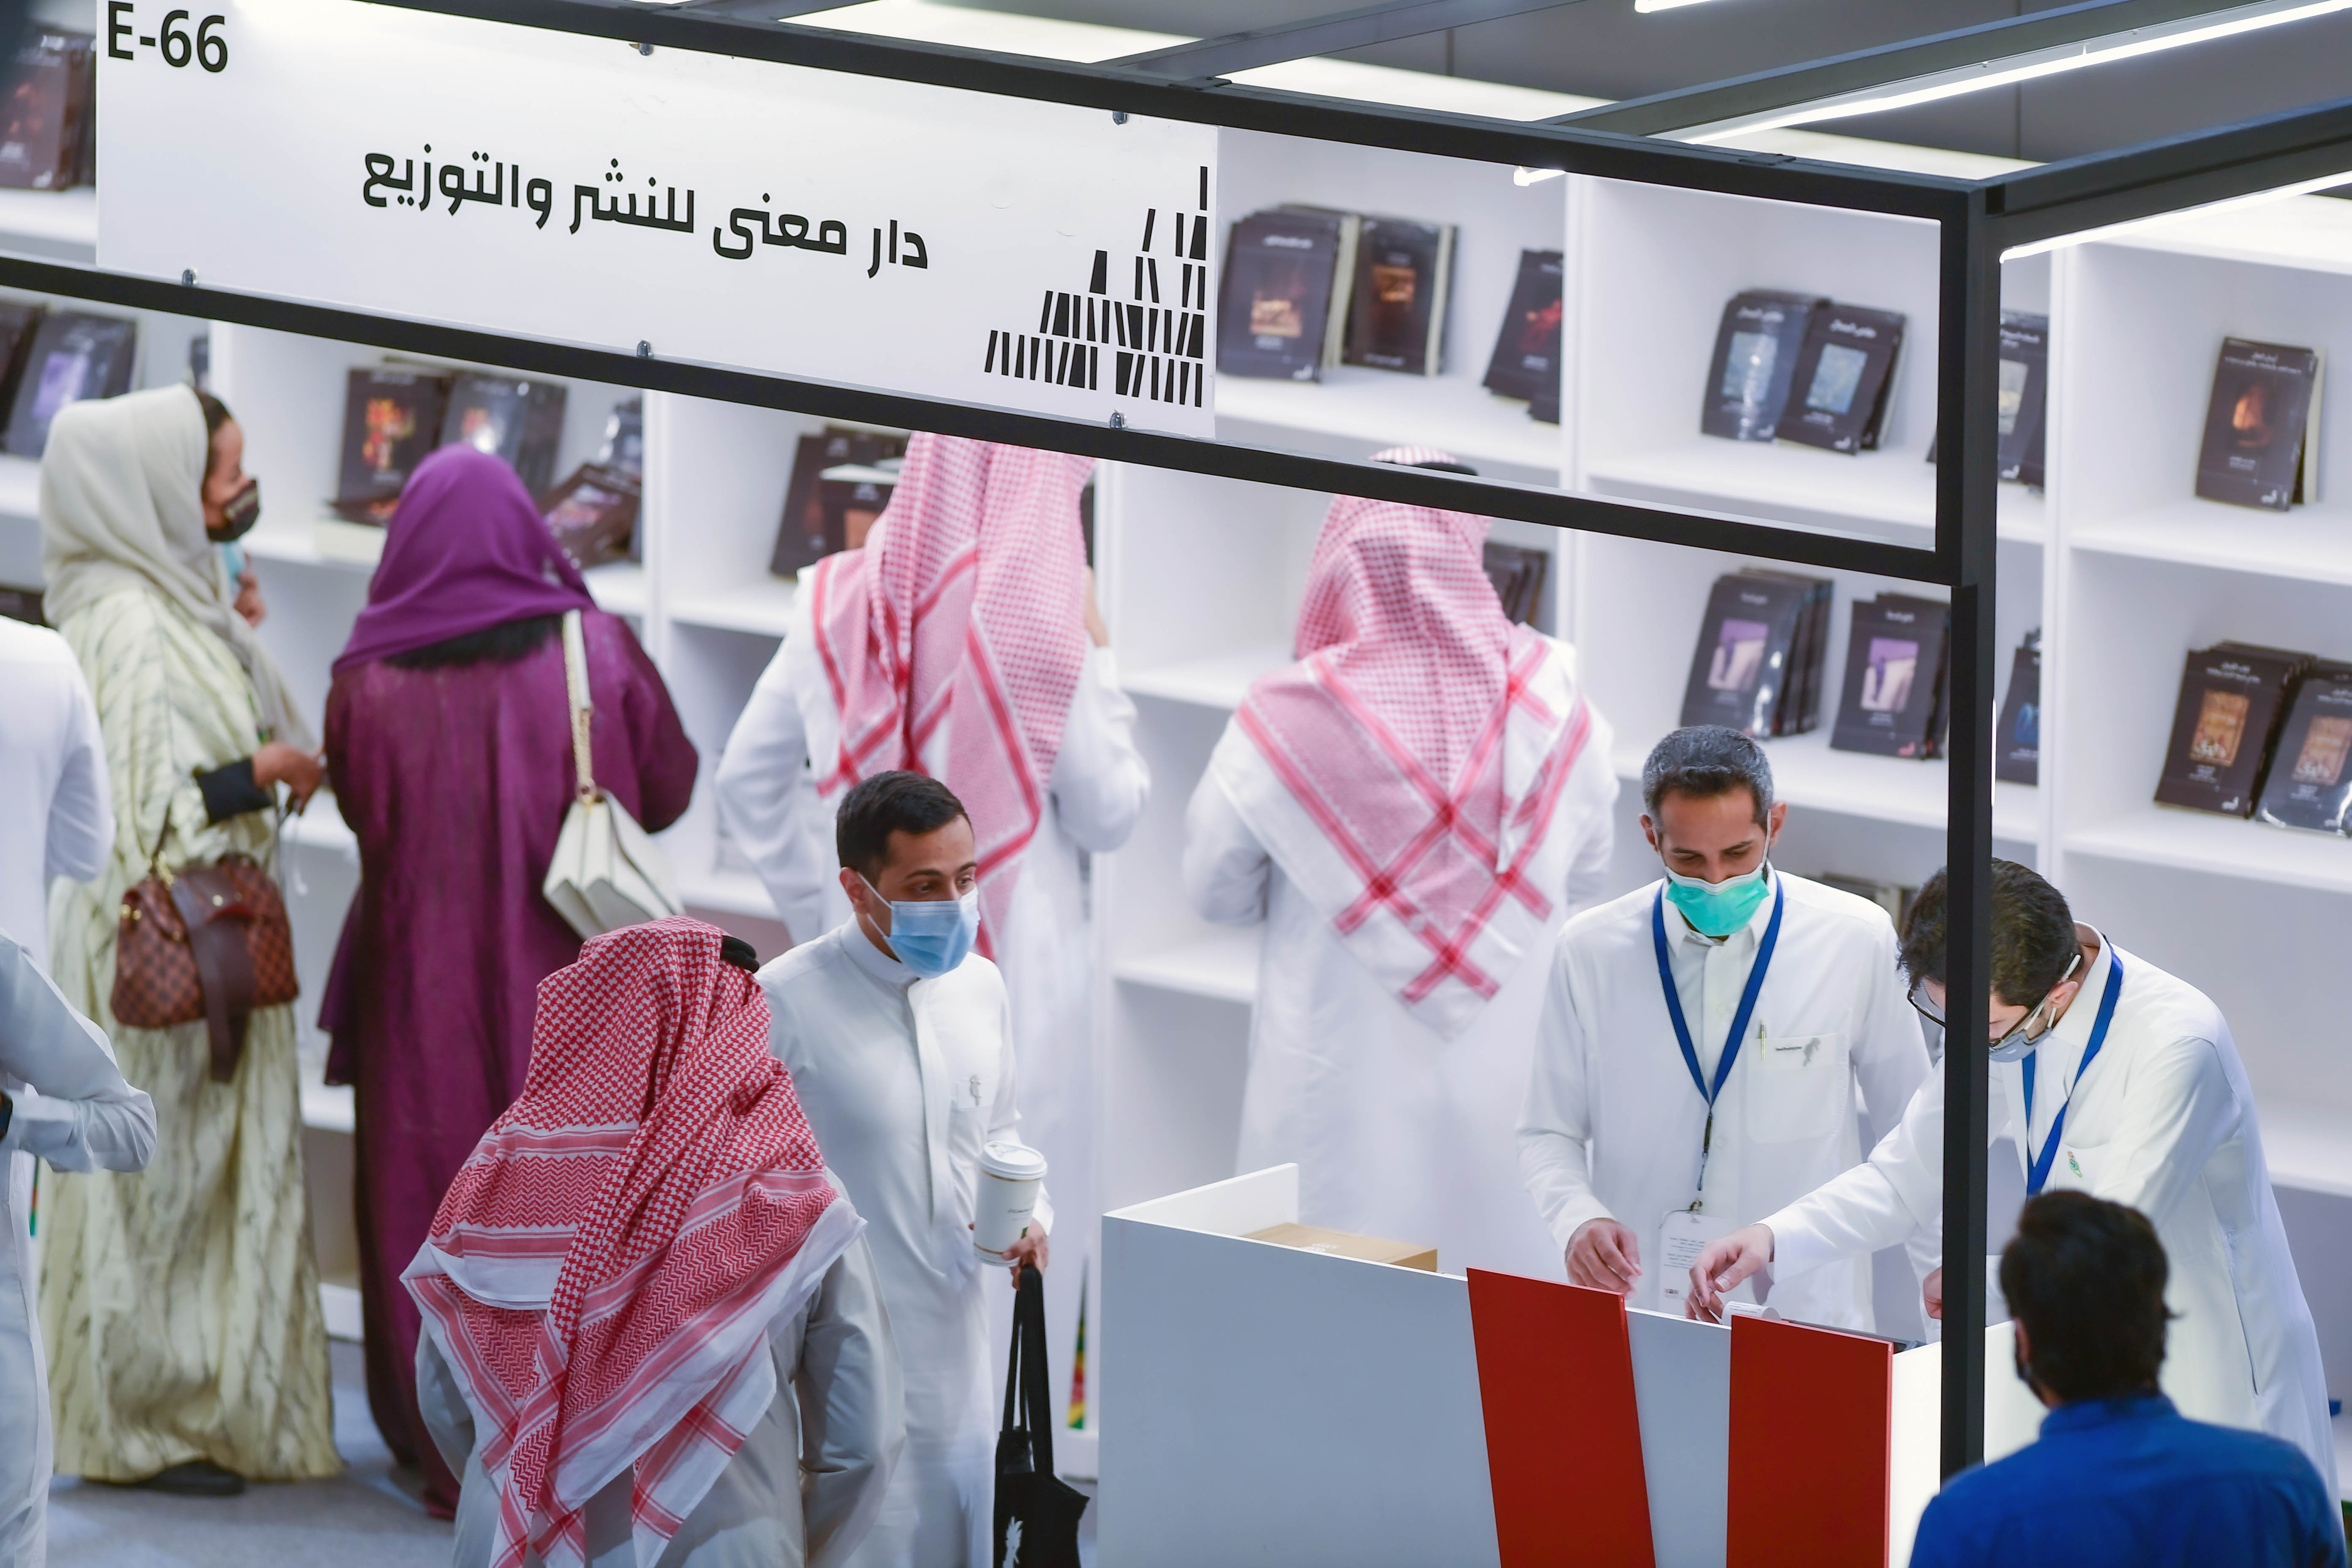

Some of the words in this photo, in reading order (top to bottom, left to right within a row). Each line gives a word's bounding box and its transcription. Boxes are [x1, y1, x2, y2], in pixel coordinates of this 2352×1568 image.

[108, 0, 228, 74] E-66
[363, 143, 553, 230] والتوزيع
[569, 158, 695, 235] للنشر
[713, 192, 847, 260] معنى
[867, 219, 928, 279] دار
